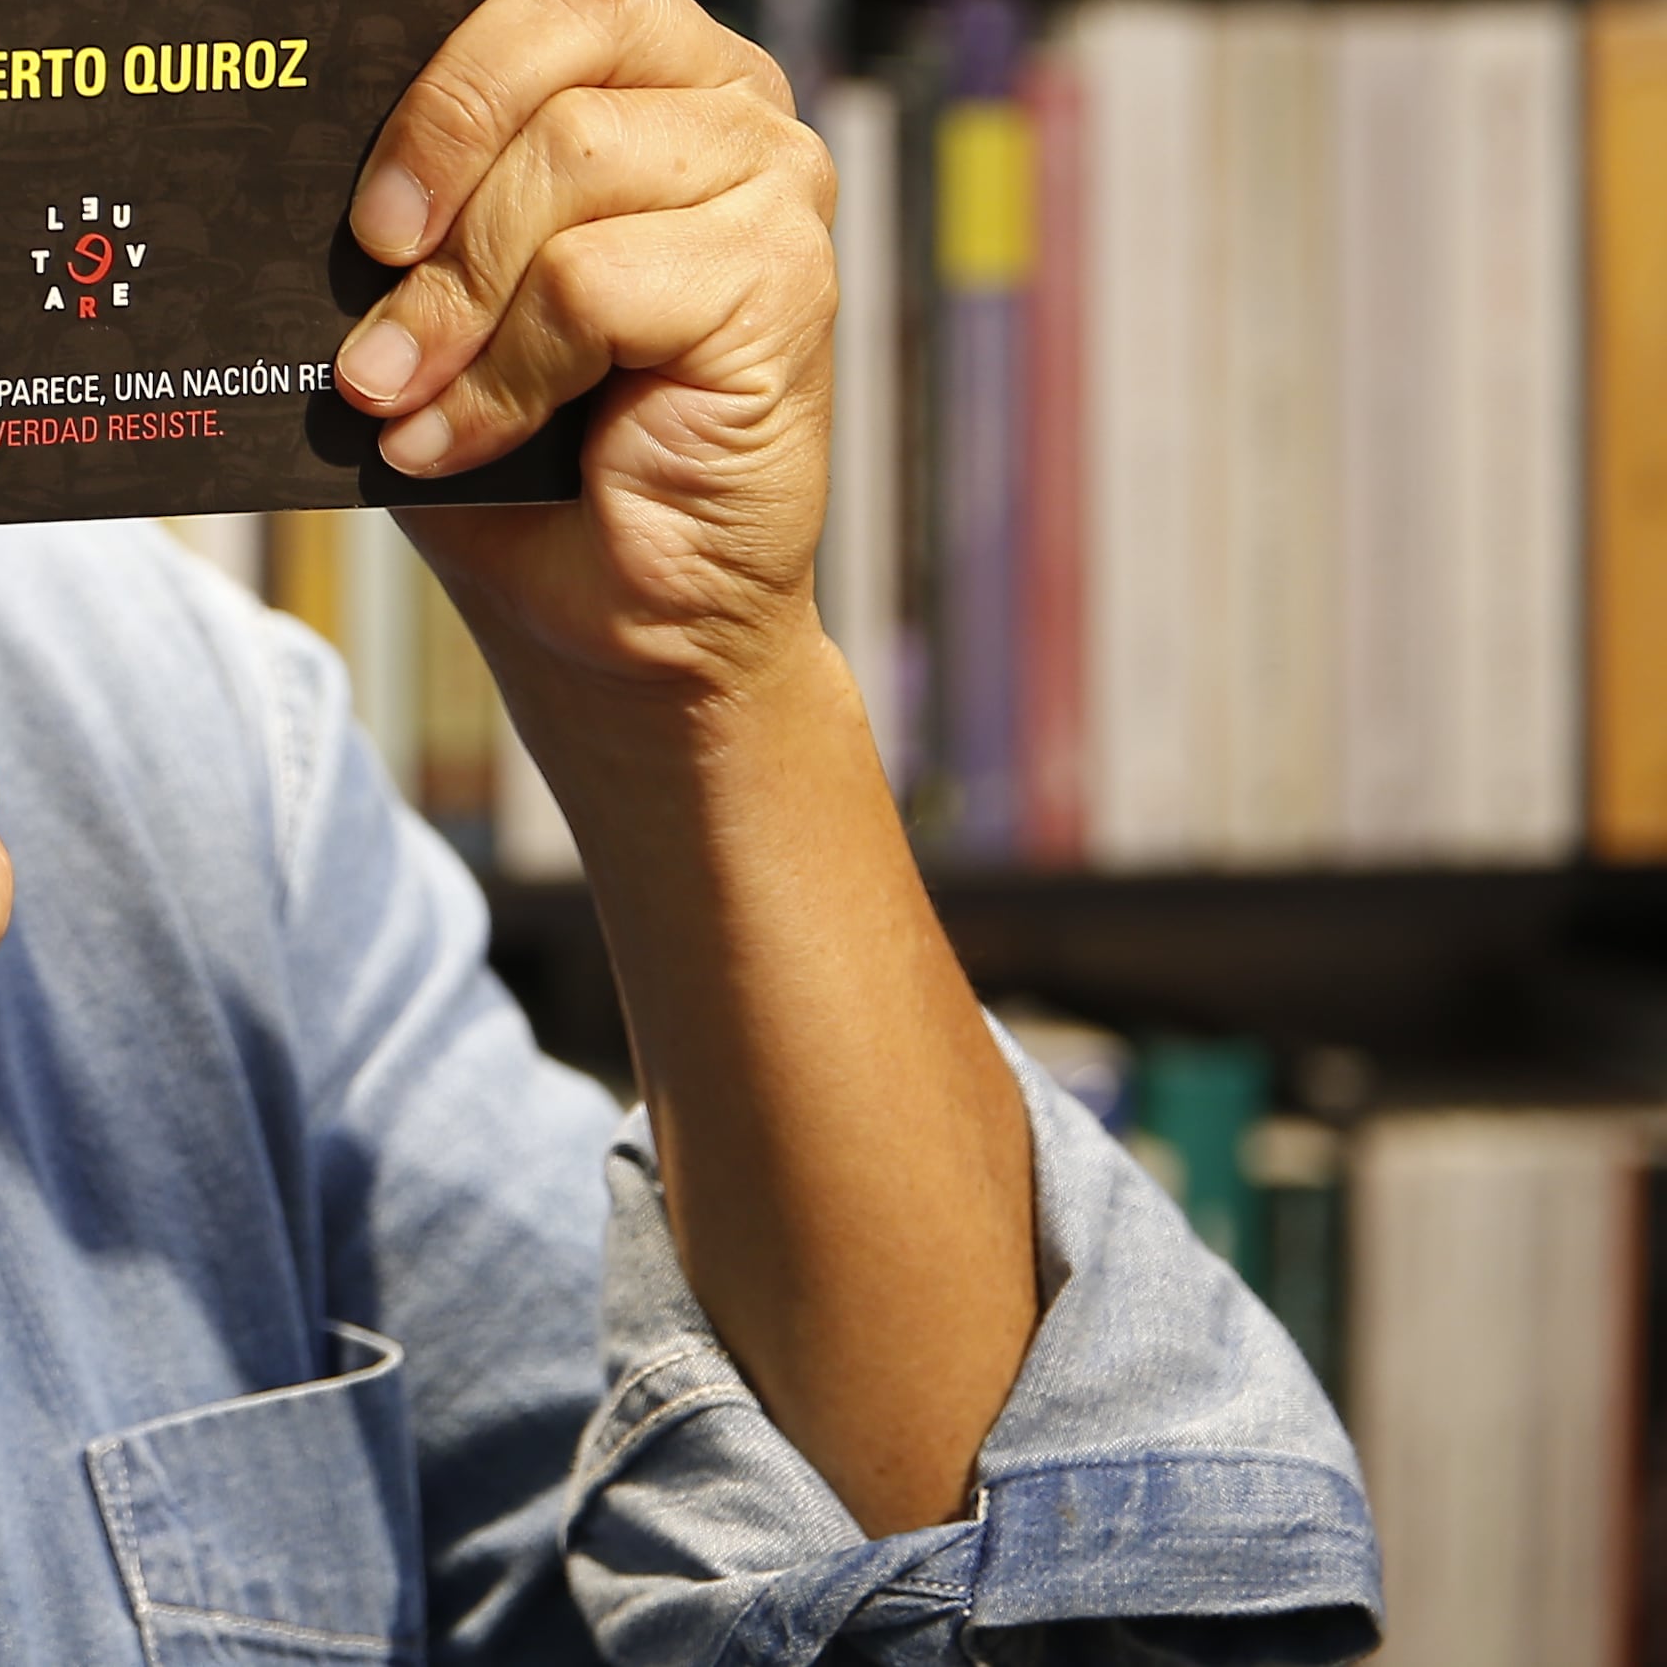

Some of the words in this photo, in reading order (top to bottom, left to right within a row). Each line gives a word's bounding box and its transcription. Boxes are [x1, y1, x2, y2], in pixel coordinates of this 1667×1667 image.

[123, 38, 309, 95] QUIROZ
[114, 370, 176, 402] UNA
[182, 358, 290, 398] NACIÓN
[107, 408, 225, 442] RESISTE.
